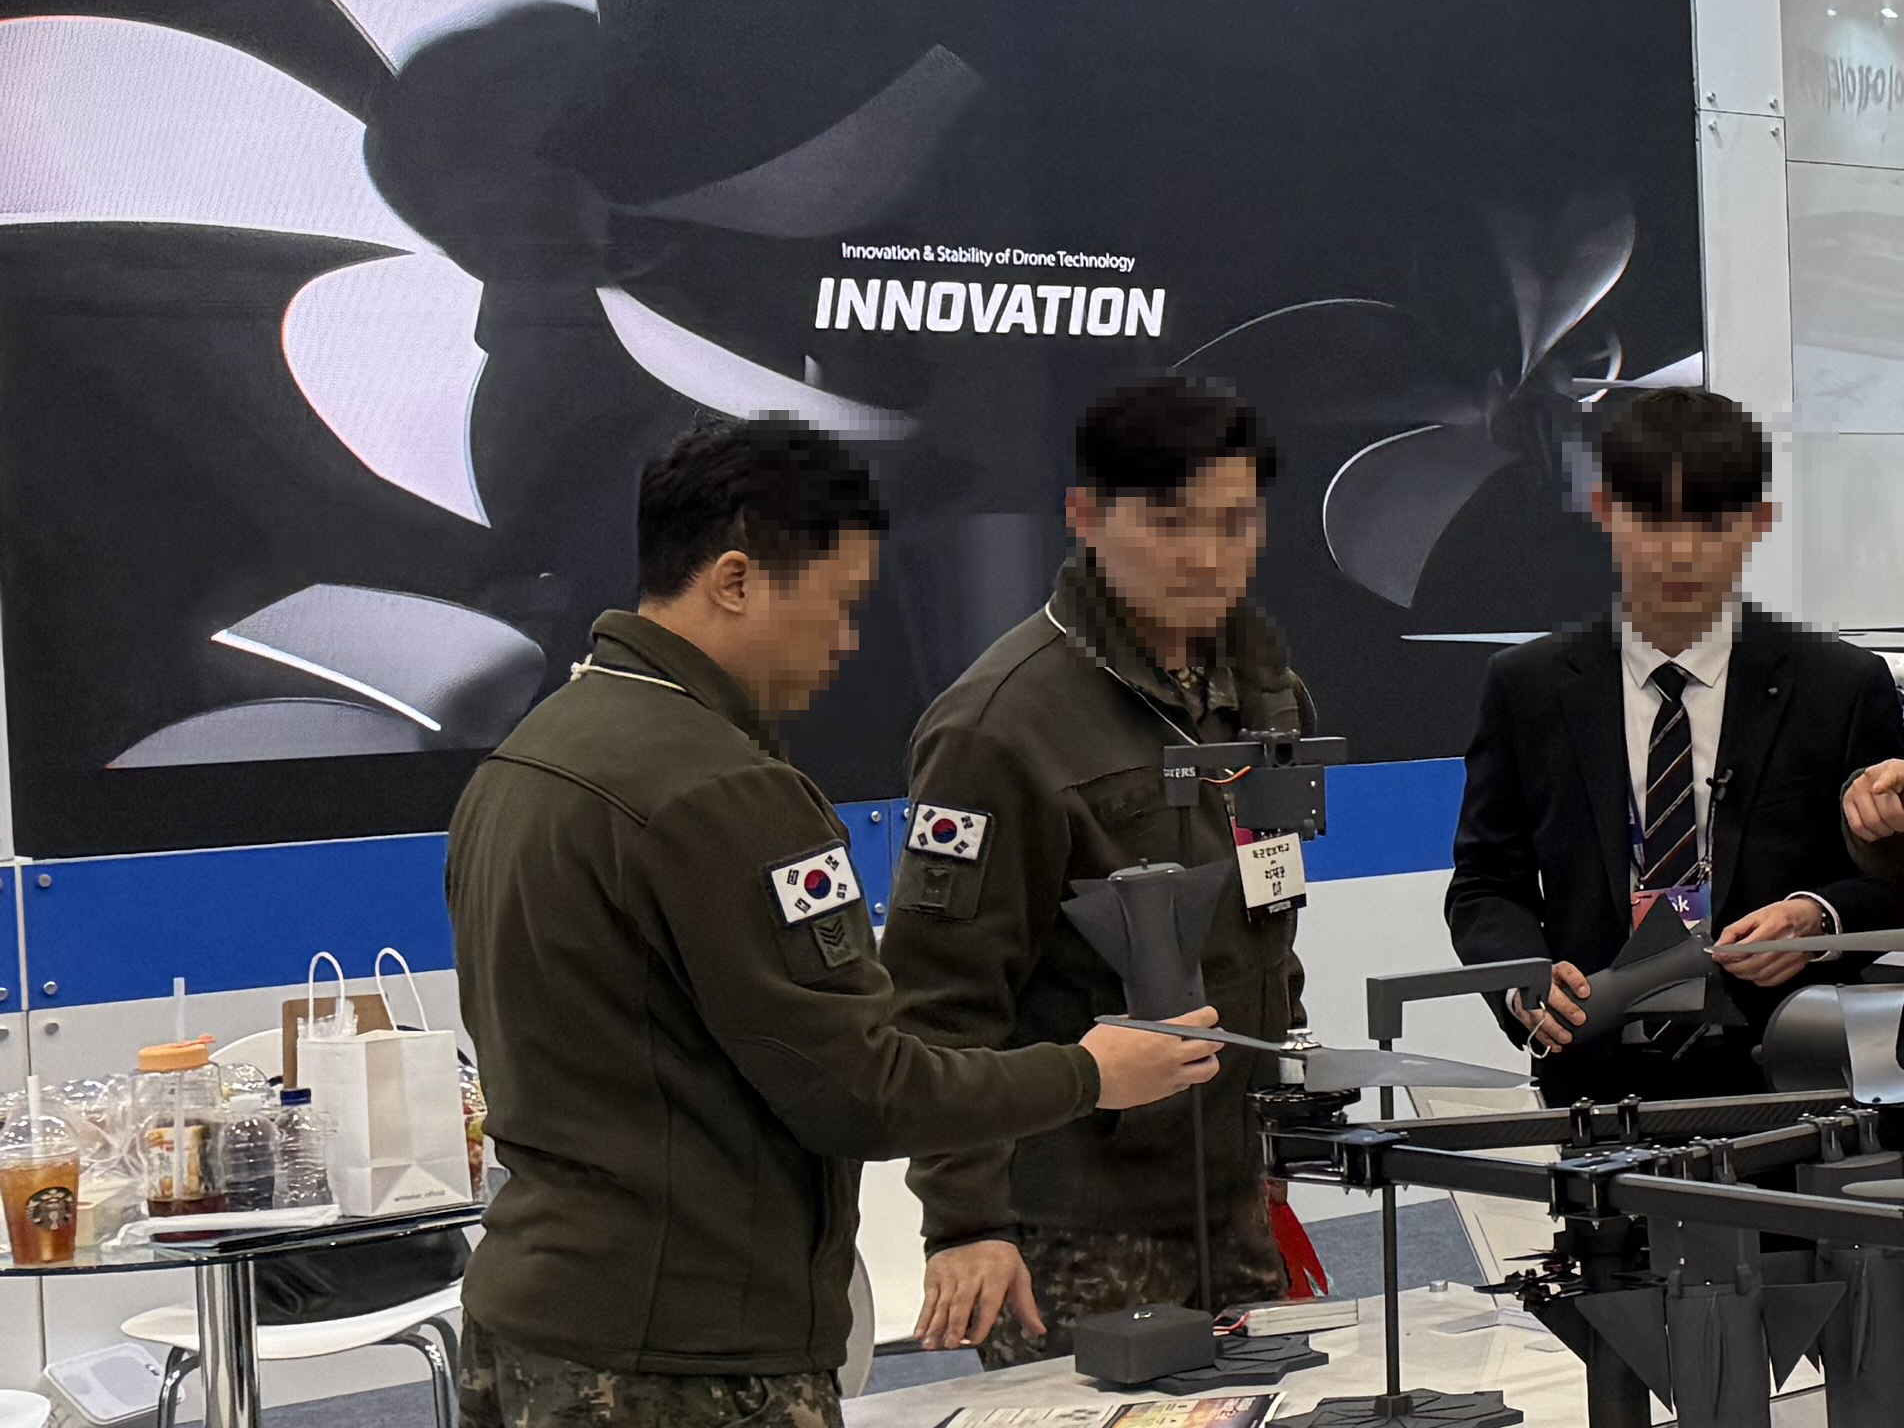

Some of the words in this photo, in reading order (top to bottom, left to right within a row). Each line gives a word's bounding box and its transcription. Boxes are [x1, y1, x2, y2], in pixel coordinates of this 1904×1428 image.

[841, 242, 920, 262] Innovation
[923, 245, 934, 262] &
[936, 245, 992, 268] Stability
[995, 247, 1011, 265] of
[1012, 249, 1057, 267] Drone
[1057, 250, 1136, 273] Technology
[814, 277, 1166, 337] INNOVATION
